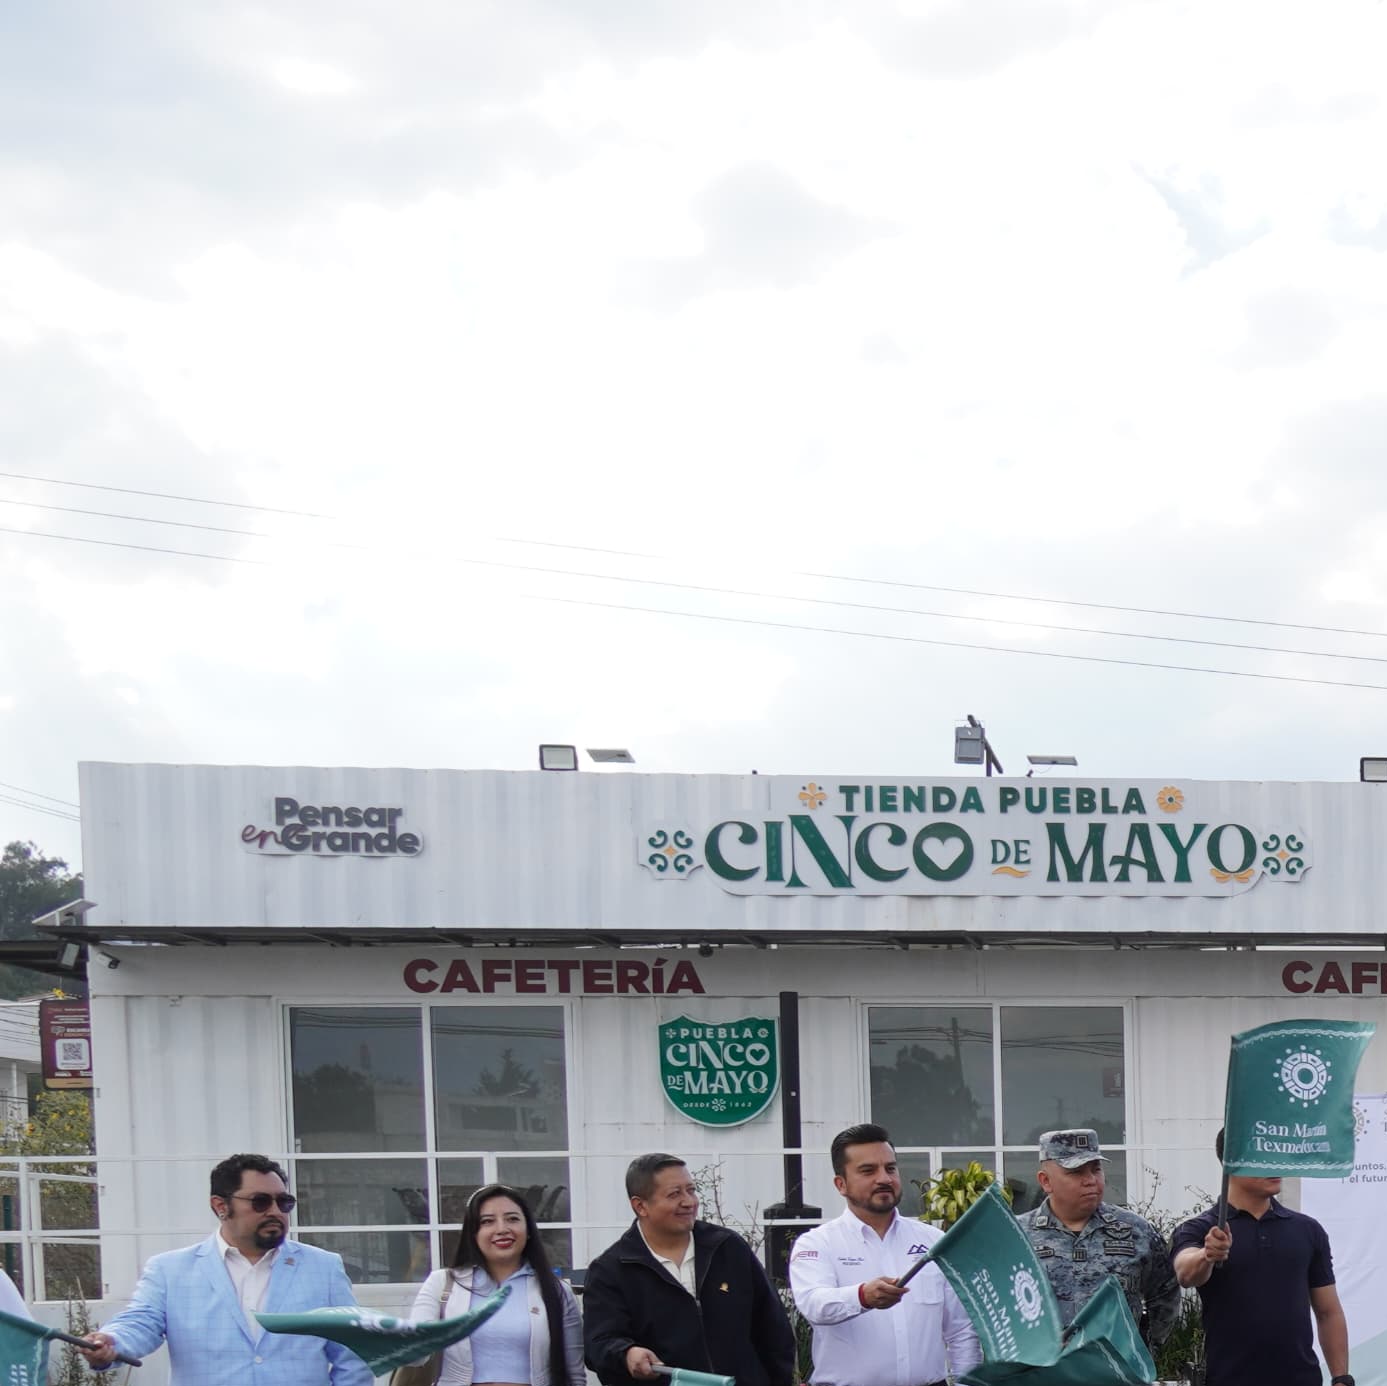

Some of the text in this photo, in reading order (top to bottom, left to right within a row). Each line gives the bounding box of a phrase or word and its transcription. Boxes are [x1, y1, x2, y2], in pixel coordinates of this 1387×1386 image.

[274, 797, 403, 828] Pensar
[839, 785, 1147, 815] TIENDA PUEBLA
[241, 823, 420, 853] en Grande
[704, 814, 1258, 889] CINCO DE MAYO
[680, 1027, 753, 1039] PUEBLA
[666, 1040, 770, 1069] CINCO
[667, 1070, 769, 1094] DE MAYO
[1255, 1120, 1289, 1137] San
[1252, 1136, 1331, 1154] Texmelucan
[1349, 1174, 1359, 1184] el
[1353, 1162, 1387, 1172] untos,
[979, 1268, 1000, 1305] San
